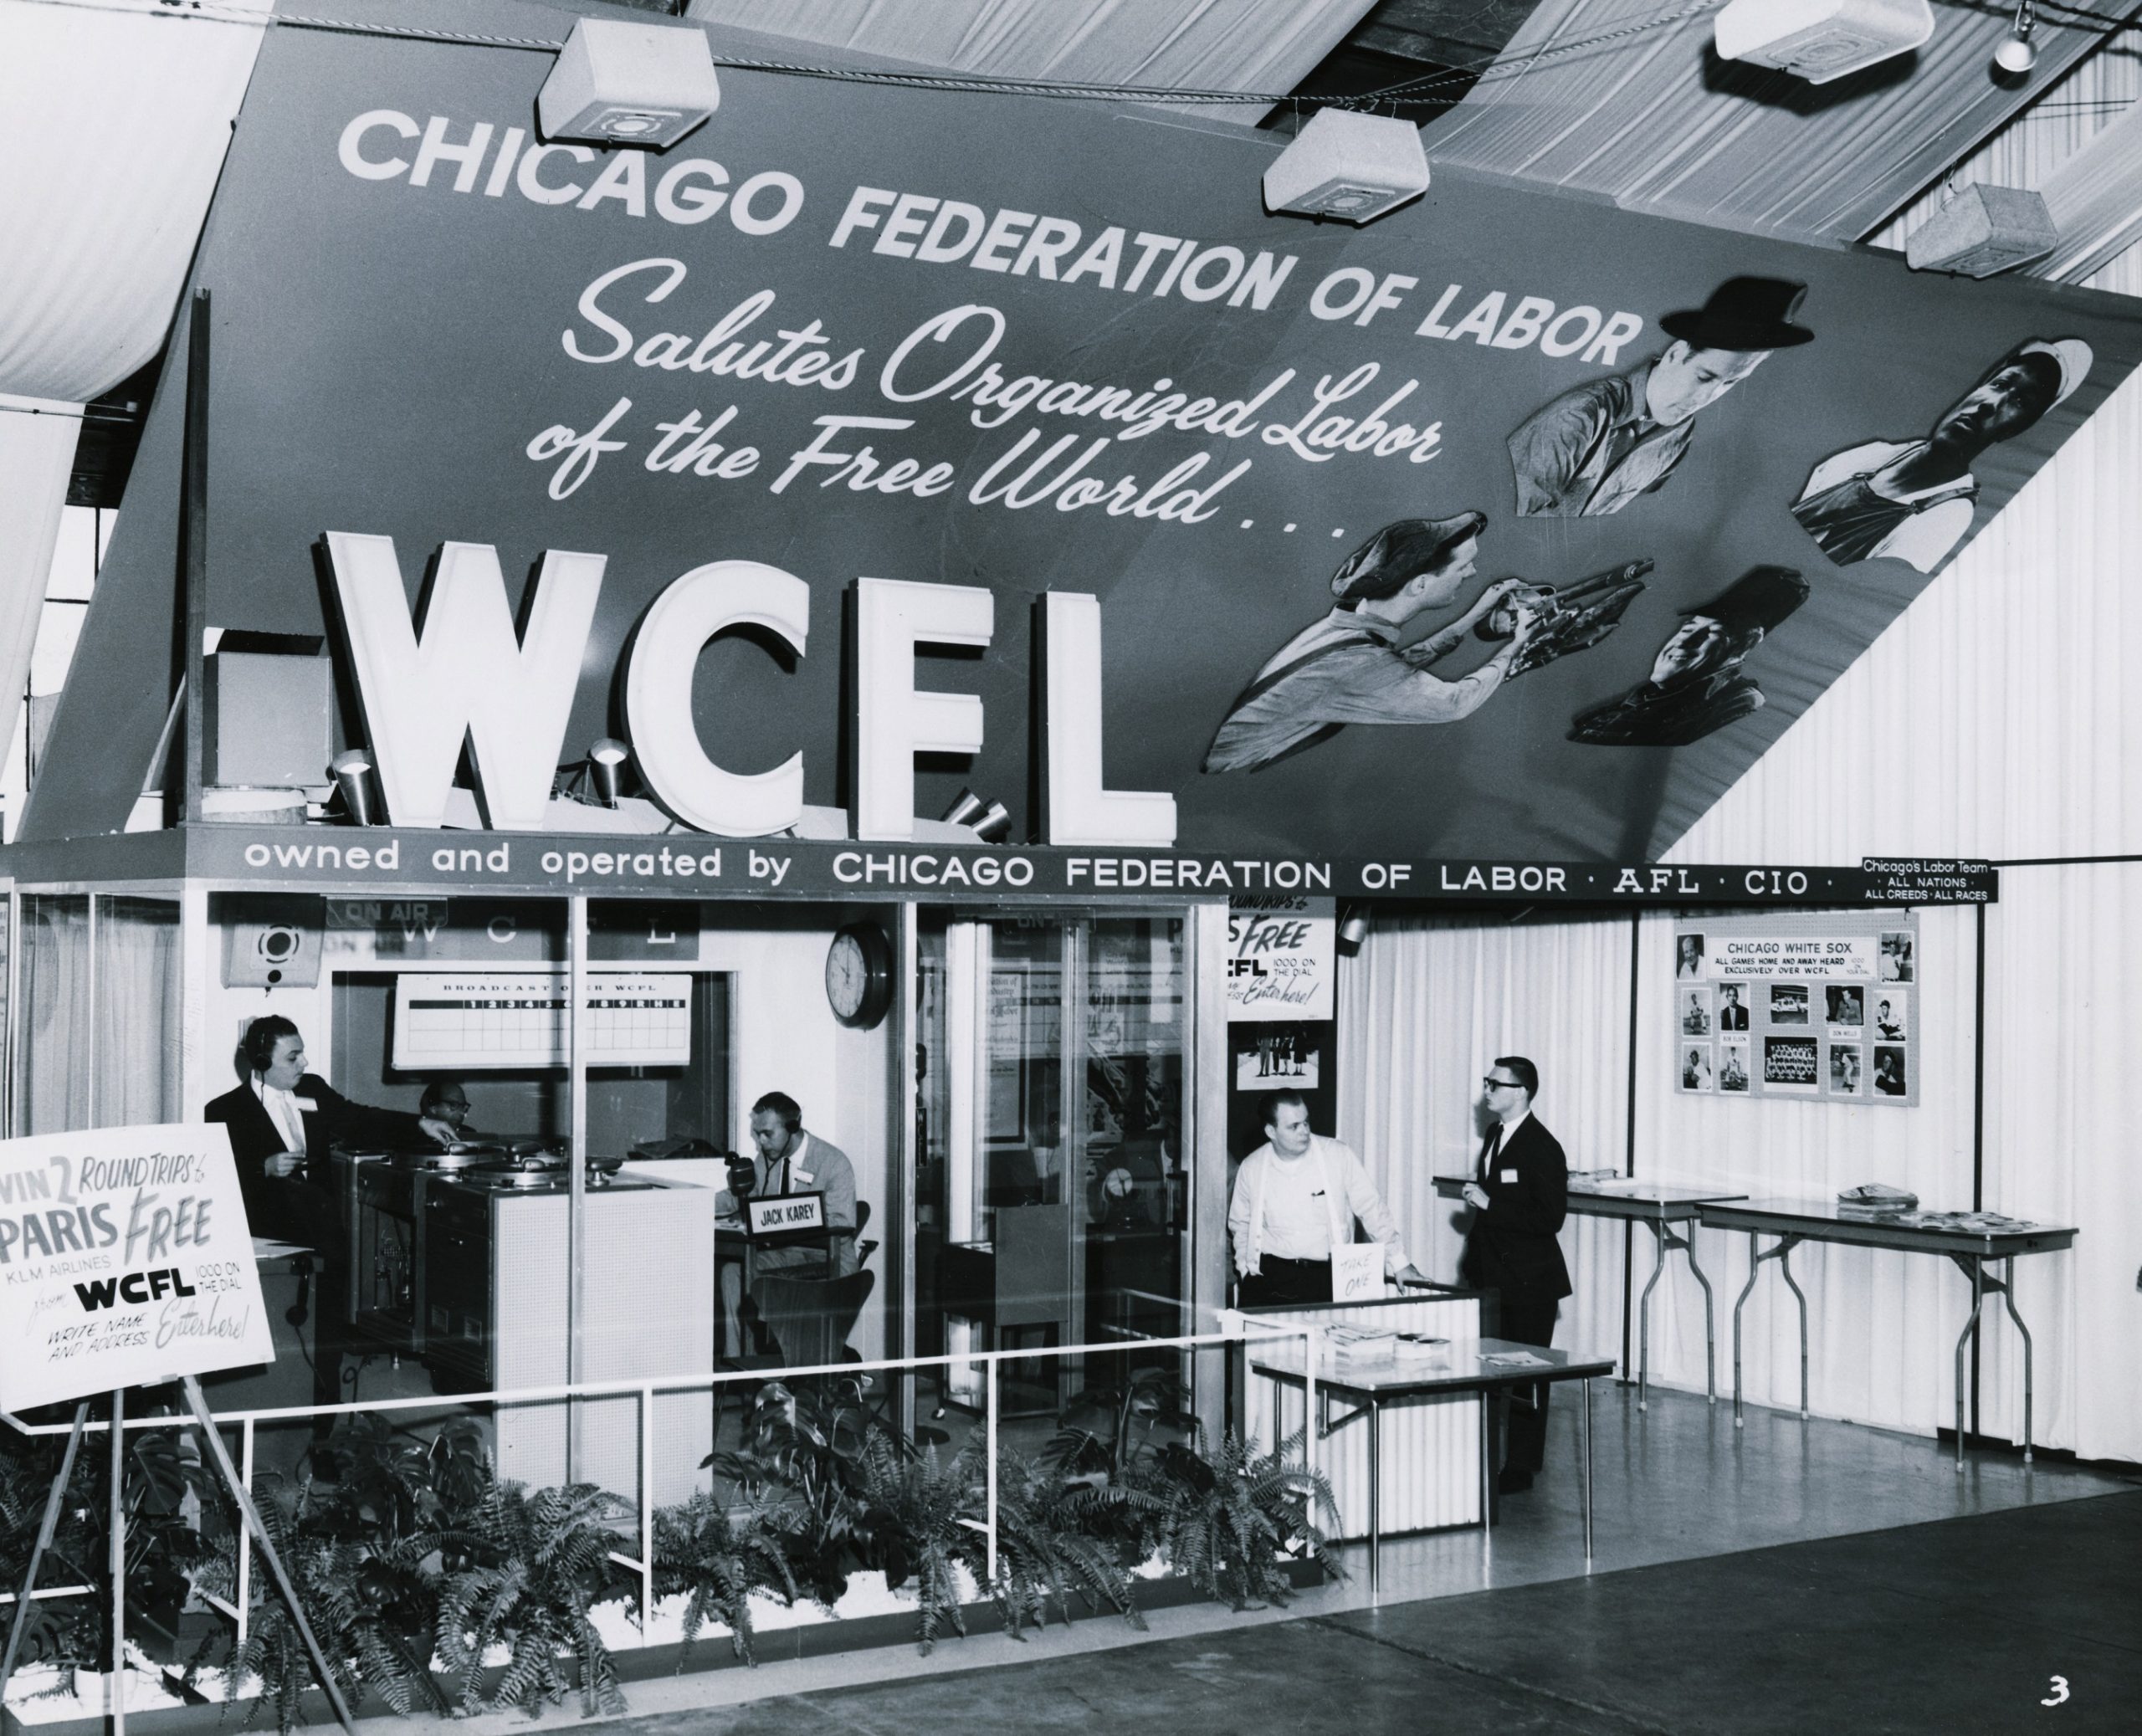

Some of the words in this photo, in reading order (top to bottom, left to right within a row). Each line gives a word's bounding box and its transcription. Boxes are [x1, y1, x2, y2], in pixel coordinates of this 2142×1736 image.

[338, 109, 804, 236] CHICAGO
[828, 186, 1297, 312] FEDERATION
[1309, 267, 1419, 328] OF
[1416, 283, 1644, 366] LABOR
[562, 258, 865, 390] Salutes
[880, 303, 1296, 440] Organized
[1261, 361, 1441, 465] Labor
[526, 397, 632, 500] of
[645, 405, 760, 479] the
[770, 415, 955, 497] Free
[968, 428, 1252, 525] World
[314, 530, 1178, 848] WCFL
[244, 840, 399, 870] owned
[433, 842, 510, 873] and
[541, 847, 721, 882] operated
[749, 849, 792, 885] by
[833, 852, 1034, 887] CHICAGO
[1067, 858, 1332, 889] FEDERATION
[1361, 863, 1412, 890] OF
[1441, 865, 1567, 892] LABOR
[1613, 868, 1700, 894] AFL
[1745, 870, 1808, 895] CIO
[1863, 859, 1921, 876] Chicago's
[1924, 860, 1955, 873] Labor
[1957, 861, 1988, 873] Team
[1865, 889, 1884, 899] ALL
[1887, 889, 1929, 900] CREEDS
[1934, 890, 1953, 900] ALL
[1955, 891, 1988, 901] RACES
[1888, 877, 1910, 887] ALL
[1917, 877, 1967, 888] NATIONS
[346, 902, 382, 920] ON
[390, 903, 429, 921] AIR
[1238, 914, 1312, 958] FREE
[1727, 943, 1780, 955] CHICAGO
[1785, 942, 1821, 954] WHITE
[1826, 942, 1852, 954] SOX
[1227, 959, 1268, 976] FL
[1273, 958, 1297, 967] 1000
[1302, 958, 1316, 967] ON
[1273, 968, 1289, 976] THE
[1293, 968, 1312, 976] DIAL
[1724, 966, 1774, 975] EXCLUSIVELY
[1778, 966, 1800, 975] OVER
[1804, 966, 1830, 975] WCFL
[49, 1155, 79, 1206] 2
[0, 1202, 118, 1264] PARIS
[124, 1186, 213, 1266] FREE
[761, 1207, 783, 1226] JACK
[787, 1203, 814, 1222] KAREY
[6, 1266, 44, 1285] KLM
[49, 1255, 112, 1279] AIRLINES
[195, 1264, 223, 1279] 1000
[225, 1262, 241, 1274] ON
[73, 1267, 197, 1313] WCFL
[198, 1281, 218, 1294] THE
[220, 1278, 242, 1292] DIAL
[47, 1321, 100, 1346] WRITE
[105, 1312, 148, 1334] NAME
[48, 1341, 83, 1363] AND
[86, 1330, 151, 1354] ADDRESS
